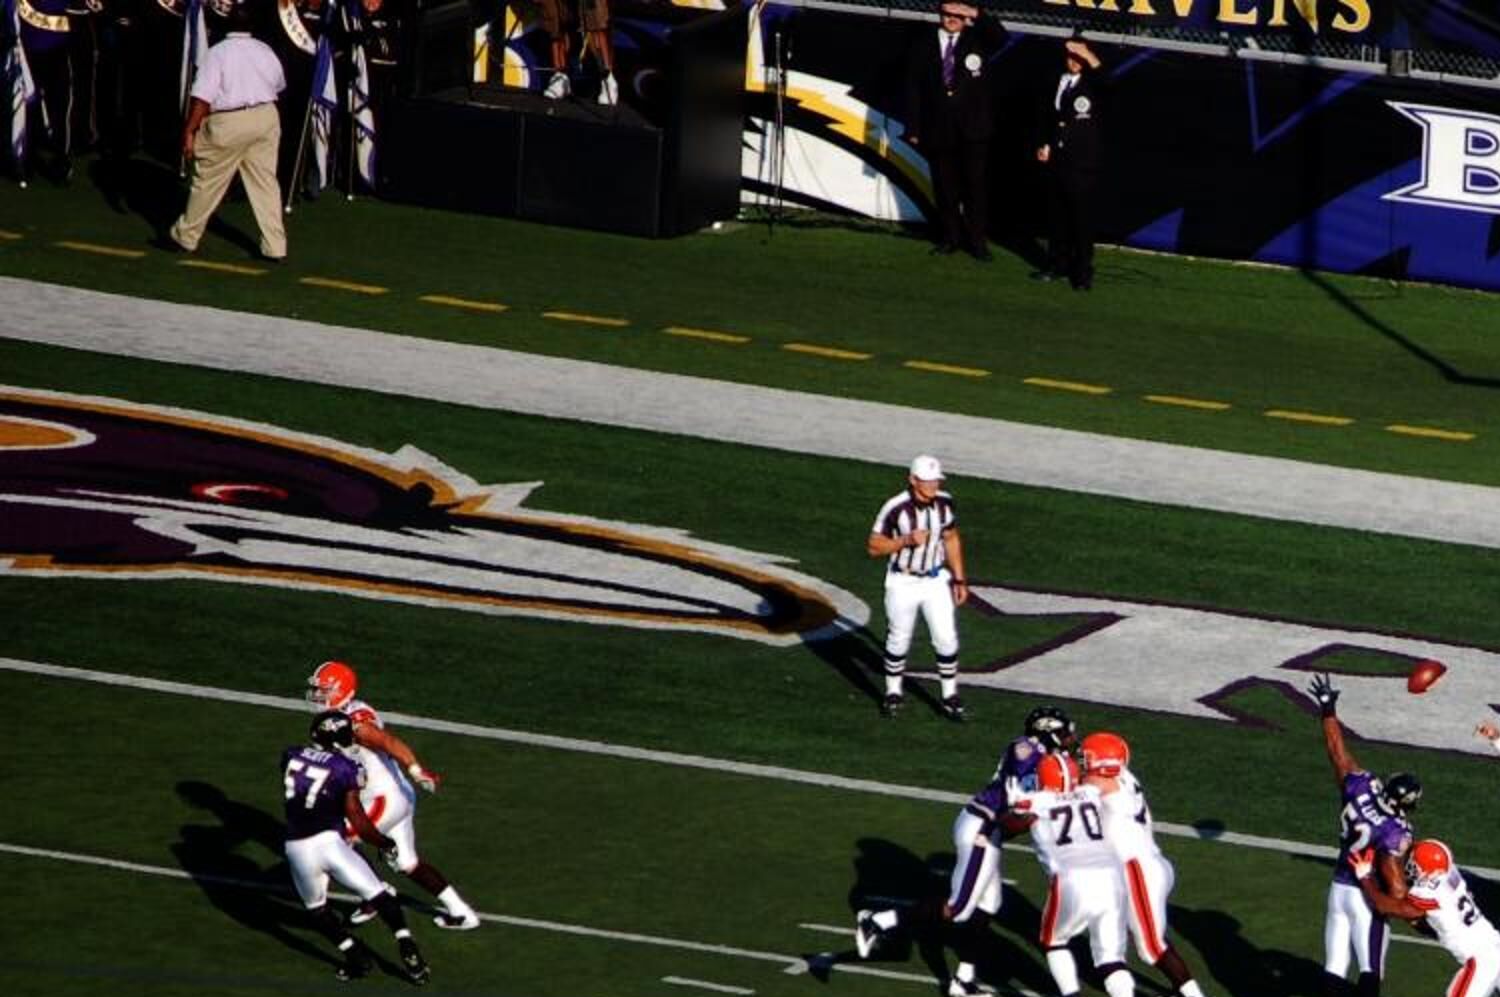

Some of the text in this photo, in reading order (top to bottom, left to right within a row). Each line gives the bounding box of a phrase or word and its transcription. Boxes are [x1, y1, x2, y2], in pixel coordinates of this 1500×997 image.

[1043, 0, 1373, 33] ENS
[284, 758, 331, 809] 57
[1050, 802, 1104, 846] 70
